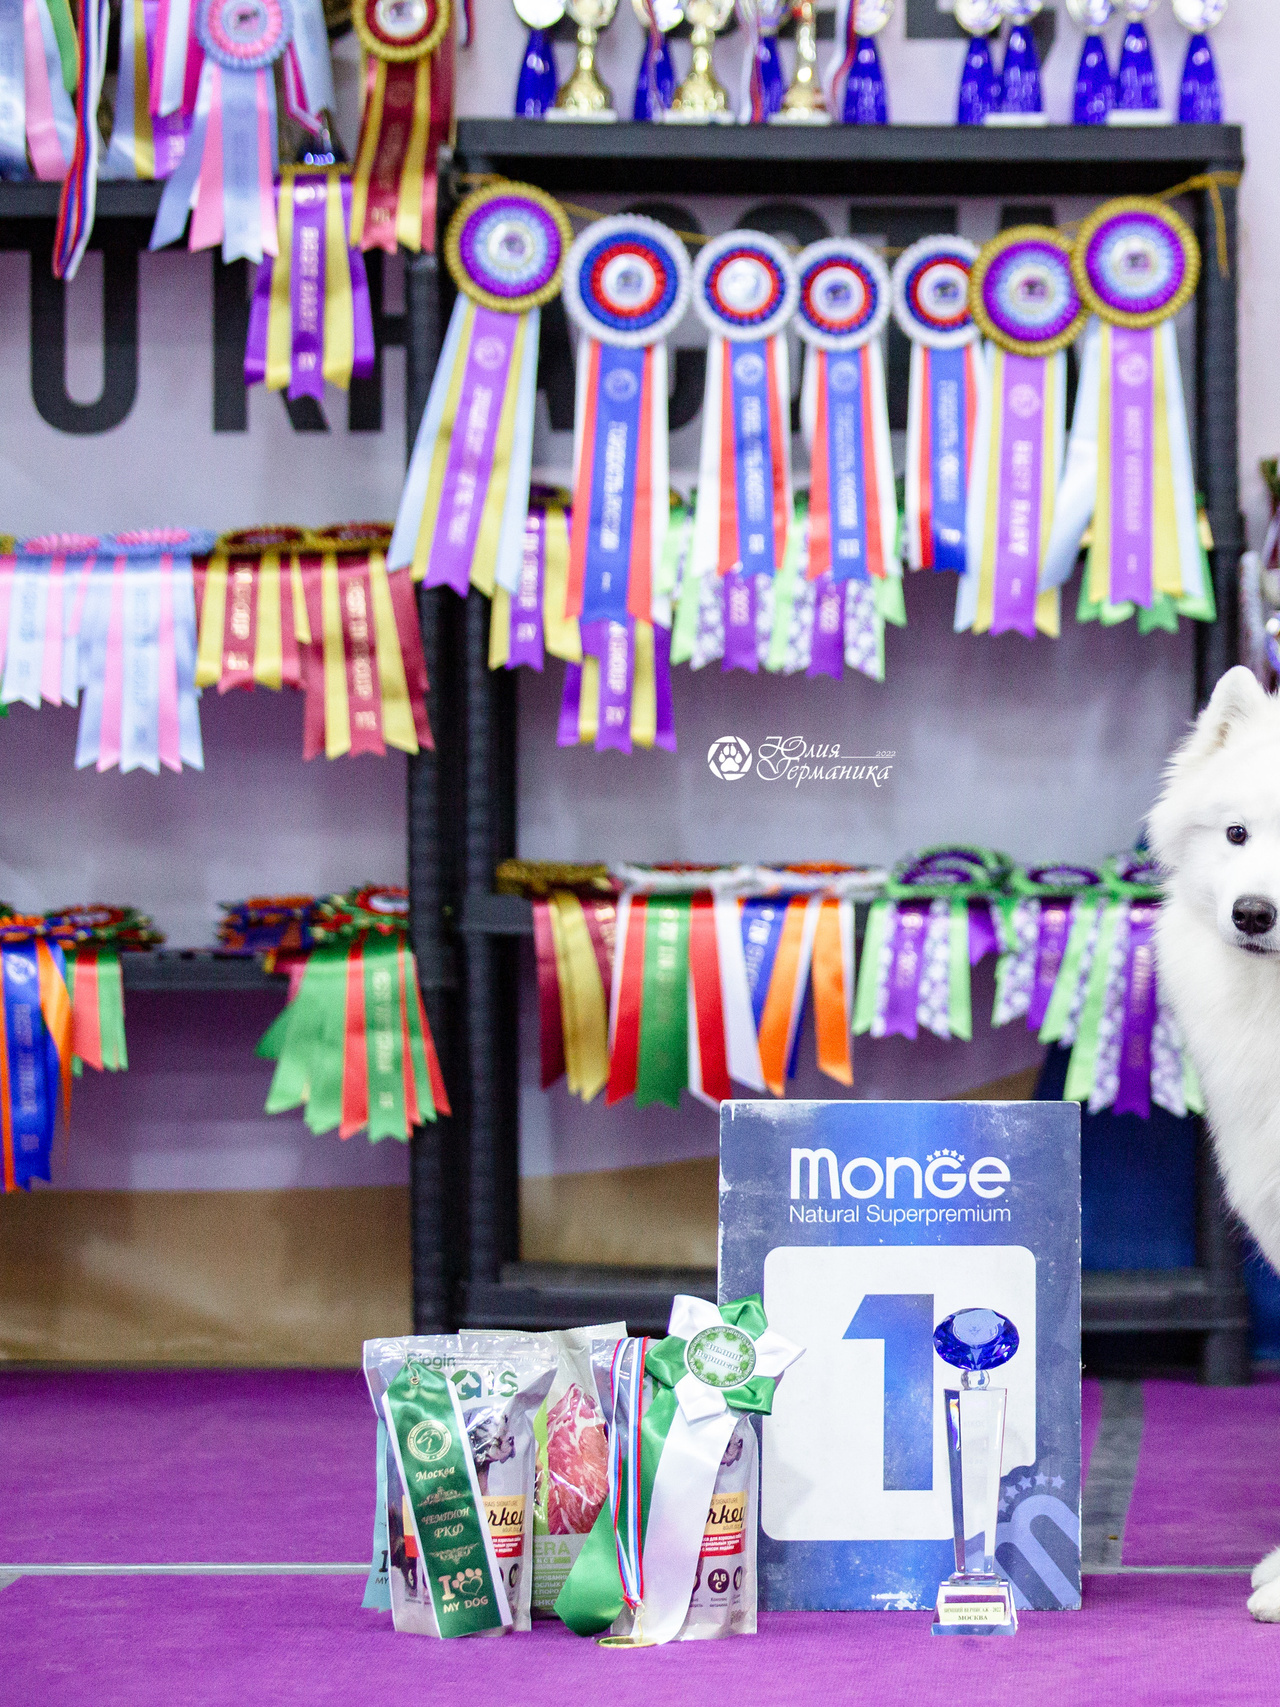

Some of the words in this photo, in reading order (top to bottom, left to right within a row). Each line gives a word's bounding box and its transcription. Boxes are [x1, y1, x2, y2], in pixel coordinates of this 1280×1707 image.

[789, 1204, 860, 1223] Natural
[866, 1204, 1011, 1226] Superpremium
[842, 1294, 935, 1491] 1
[415, 1466, 455, 1483] Москва
[421, 1507, 470, 1525] ЧЕМПИОН
[487, 1507, 525, 1532] rkey
[706, 1504, 746, 1529] rkey
[433, 1523, 464, 1538] РКФ
[438, 1575, 456, 1601] I
[443, 1602, 460, 1614] MY
[464, 1596, 489, 1610] DOG
